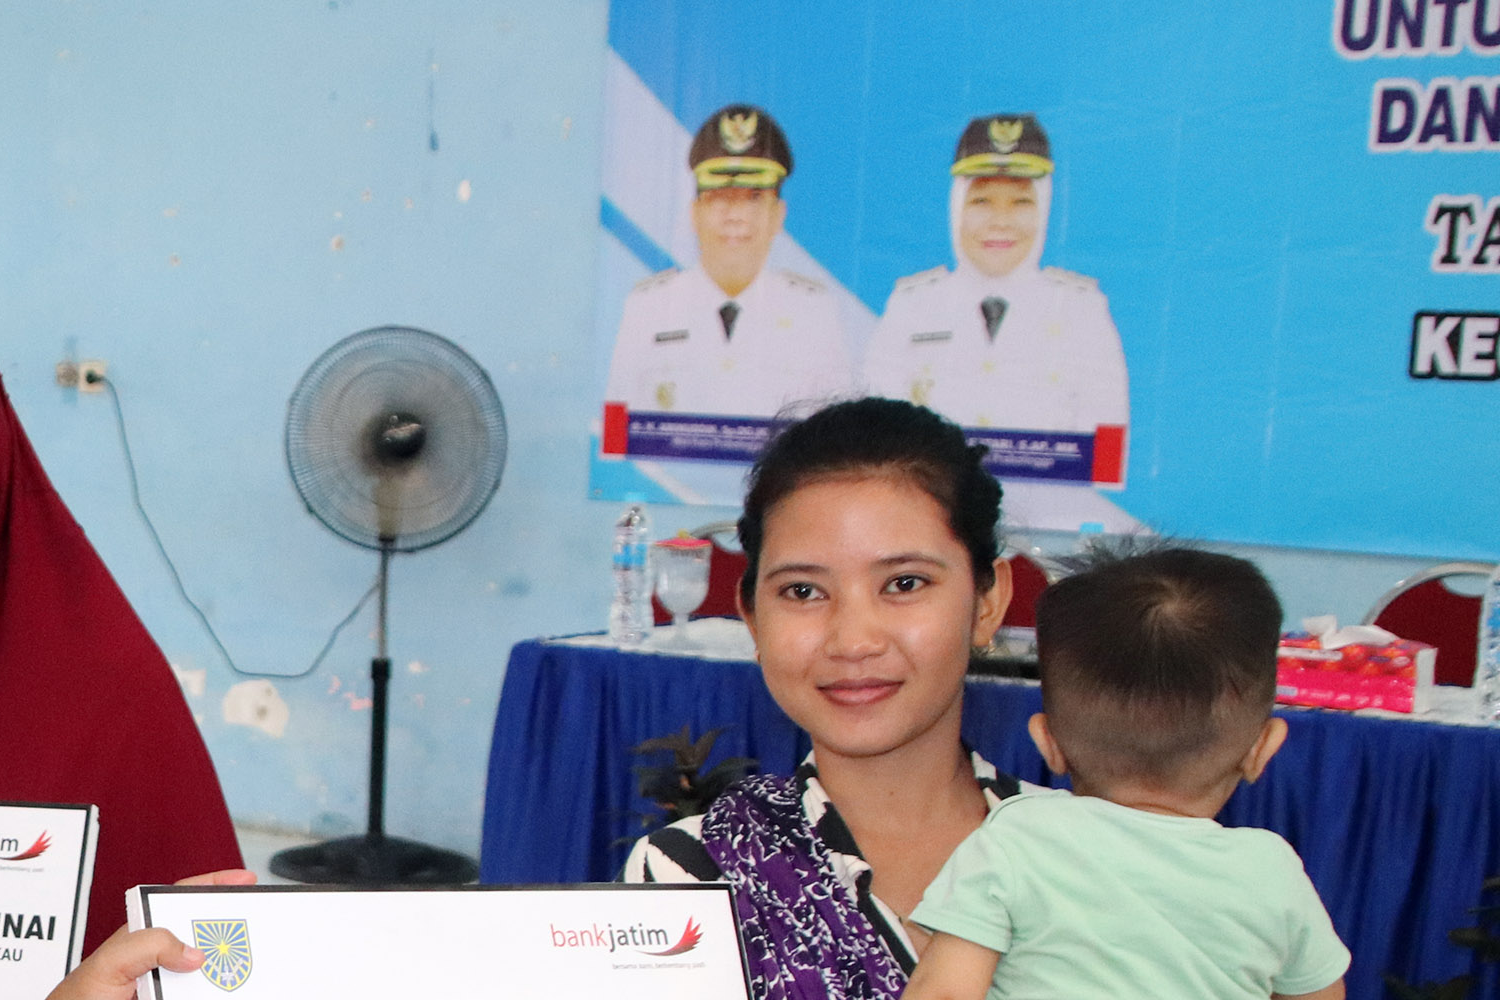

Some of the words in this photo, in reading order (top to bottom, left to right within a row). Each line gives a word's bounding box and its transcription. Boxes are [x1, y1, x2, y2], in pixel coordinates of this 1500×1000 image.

[1376, 84, 1500, 144] DAN
[1411, 313, 1500, 378] KE
[550, 923, 669, 953] bankjatim
